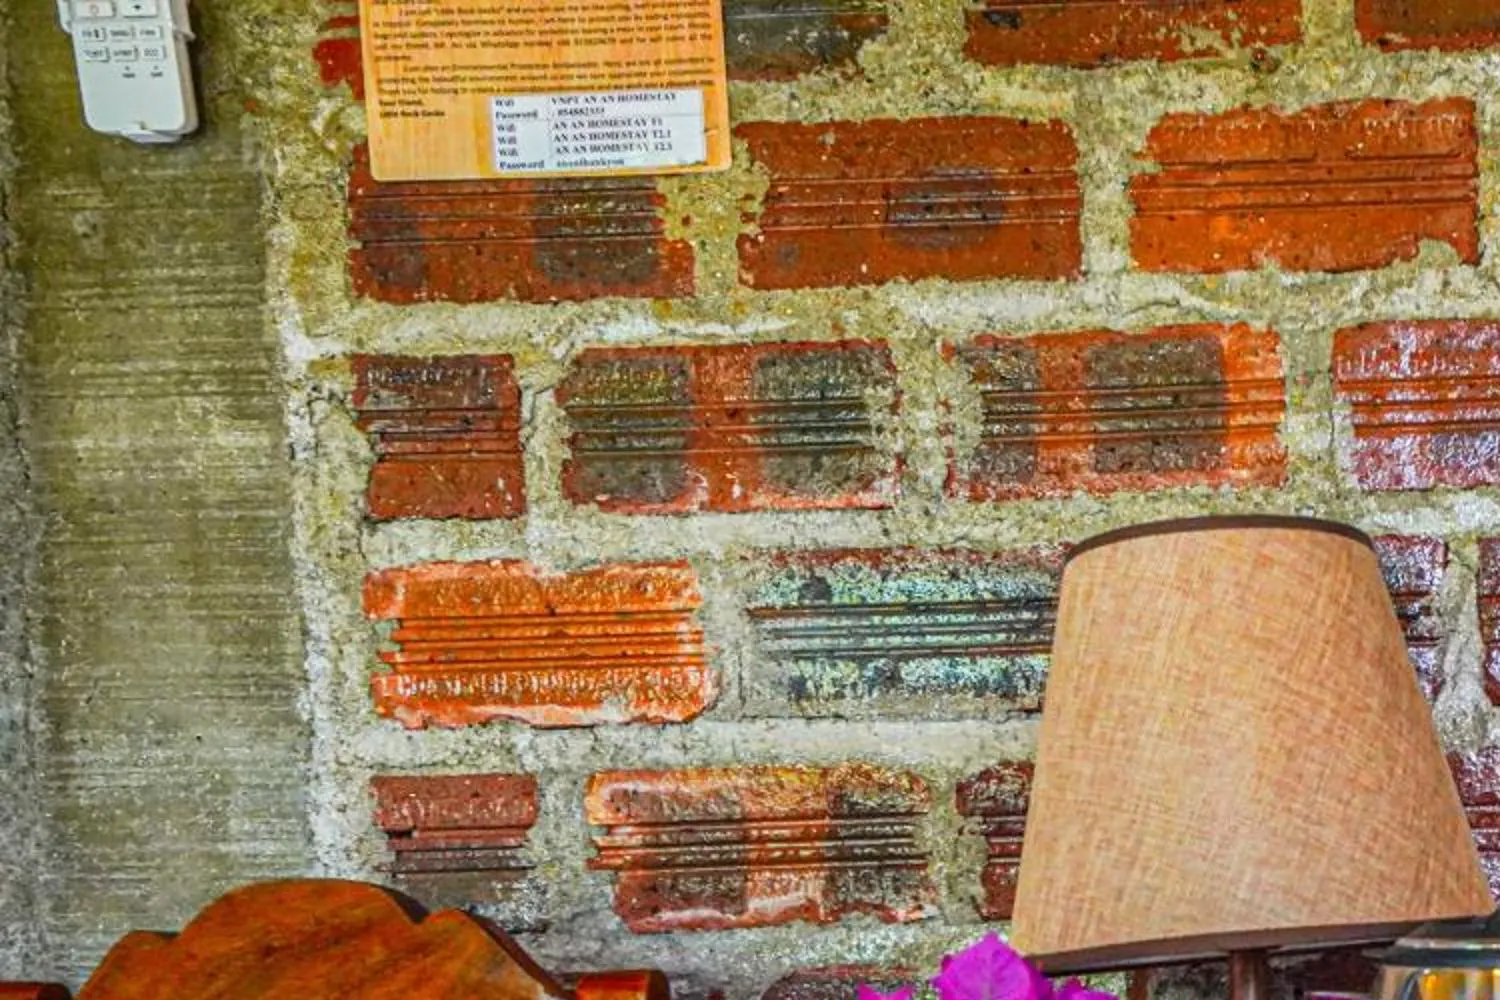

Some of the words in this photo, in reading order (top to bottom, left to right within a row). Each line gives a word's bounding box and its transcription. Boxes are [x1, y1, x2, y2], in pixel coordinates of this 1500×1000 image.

[617, 92, 677, 102] HOMESTAY
[587, 117, 648, 128] HOMESTAY
[588, 130, 648, 141] HOMESTAY
